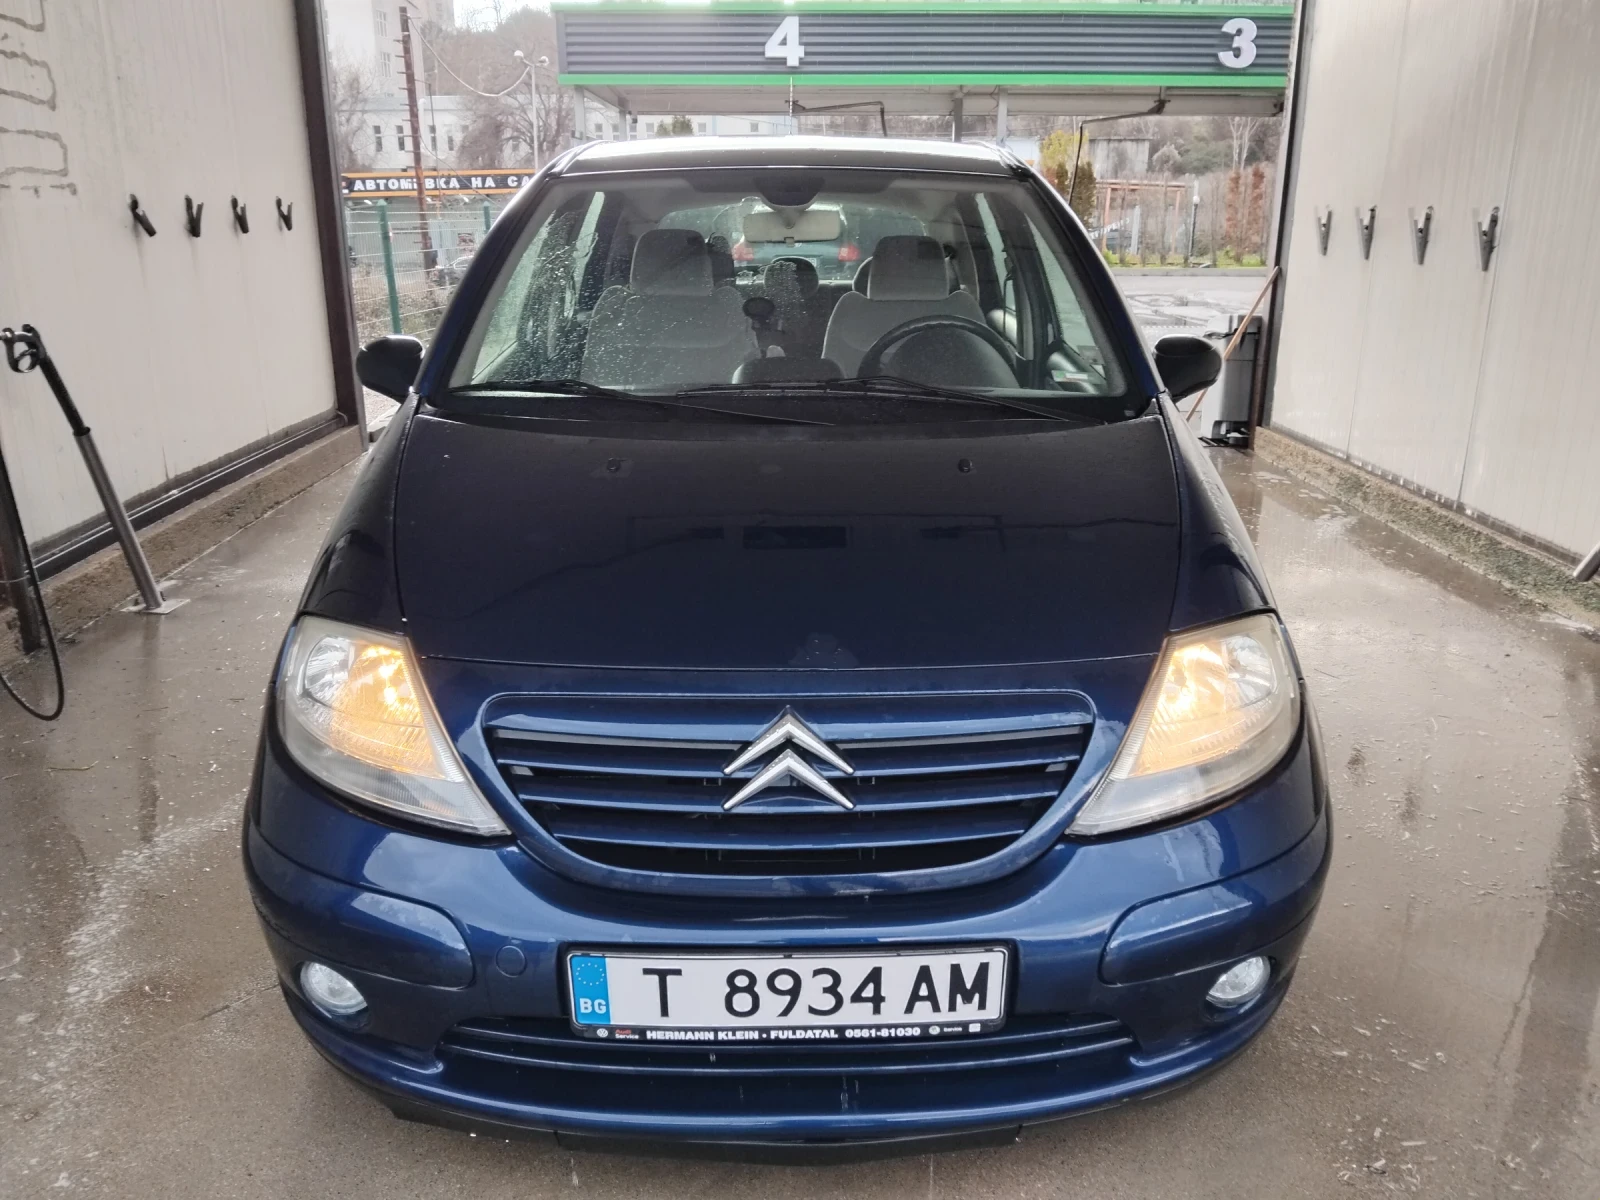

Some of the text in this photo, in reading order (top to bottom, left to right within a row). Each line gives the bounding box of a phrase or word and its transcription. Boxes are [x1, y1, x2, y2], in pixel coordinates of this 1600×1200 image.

[765, 16, 804, 66] 4
[1218, 18, 1257, 68] 3
[471, 177, 496, 188] НА
[580, 998, 607, 1014] BG
[642, 961, 990, 1018] T 8934 AM
[646, 1027, 921, 1040] HERMANN KLEIN FULDATAL 0561-81030
